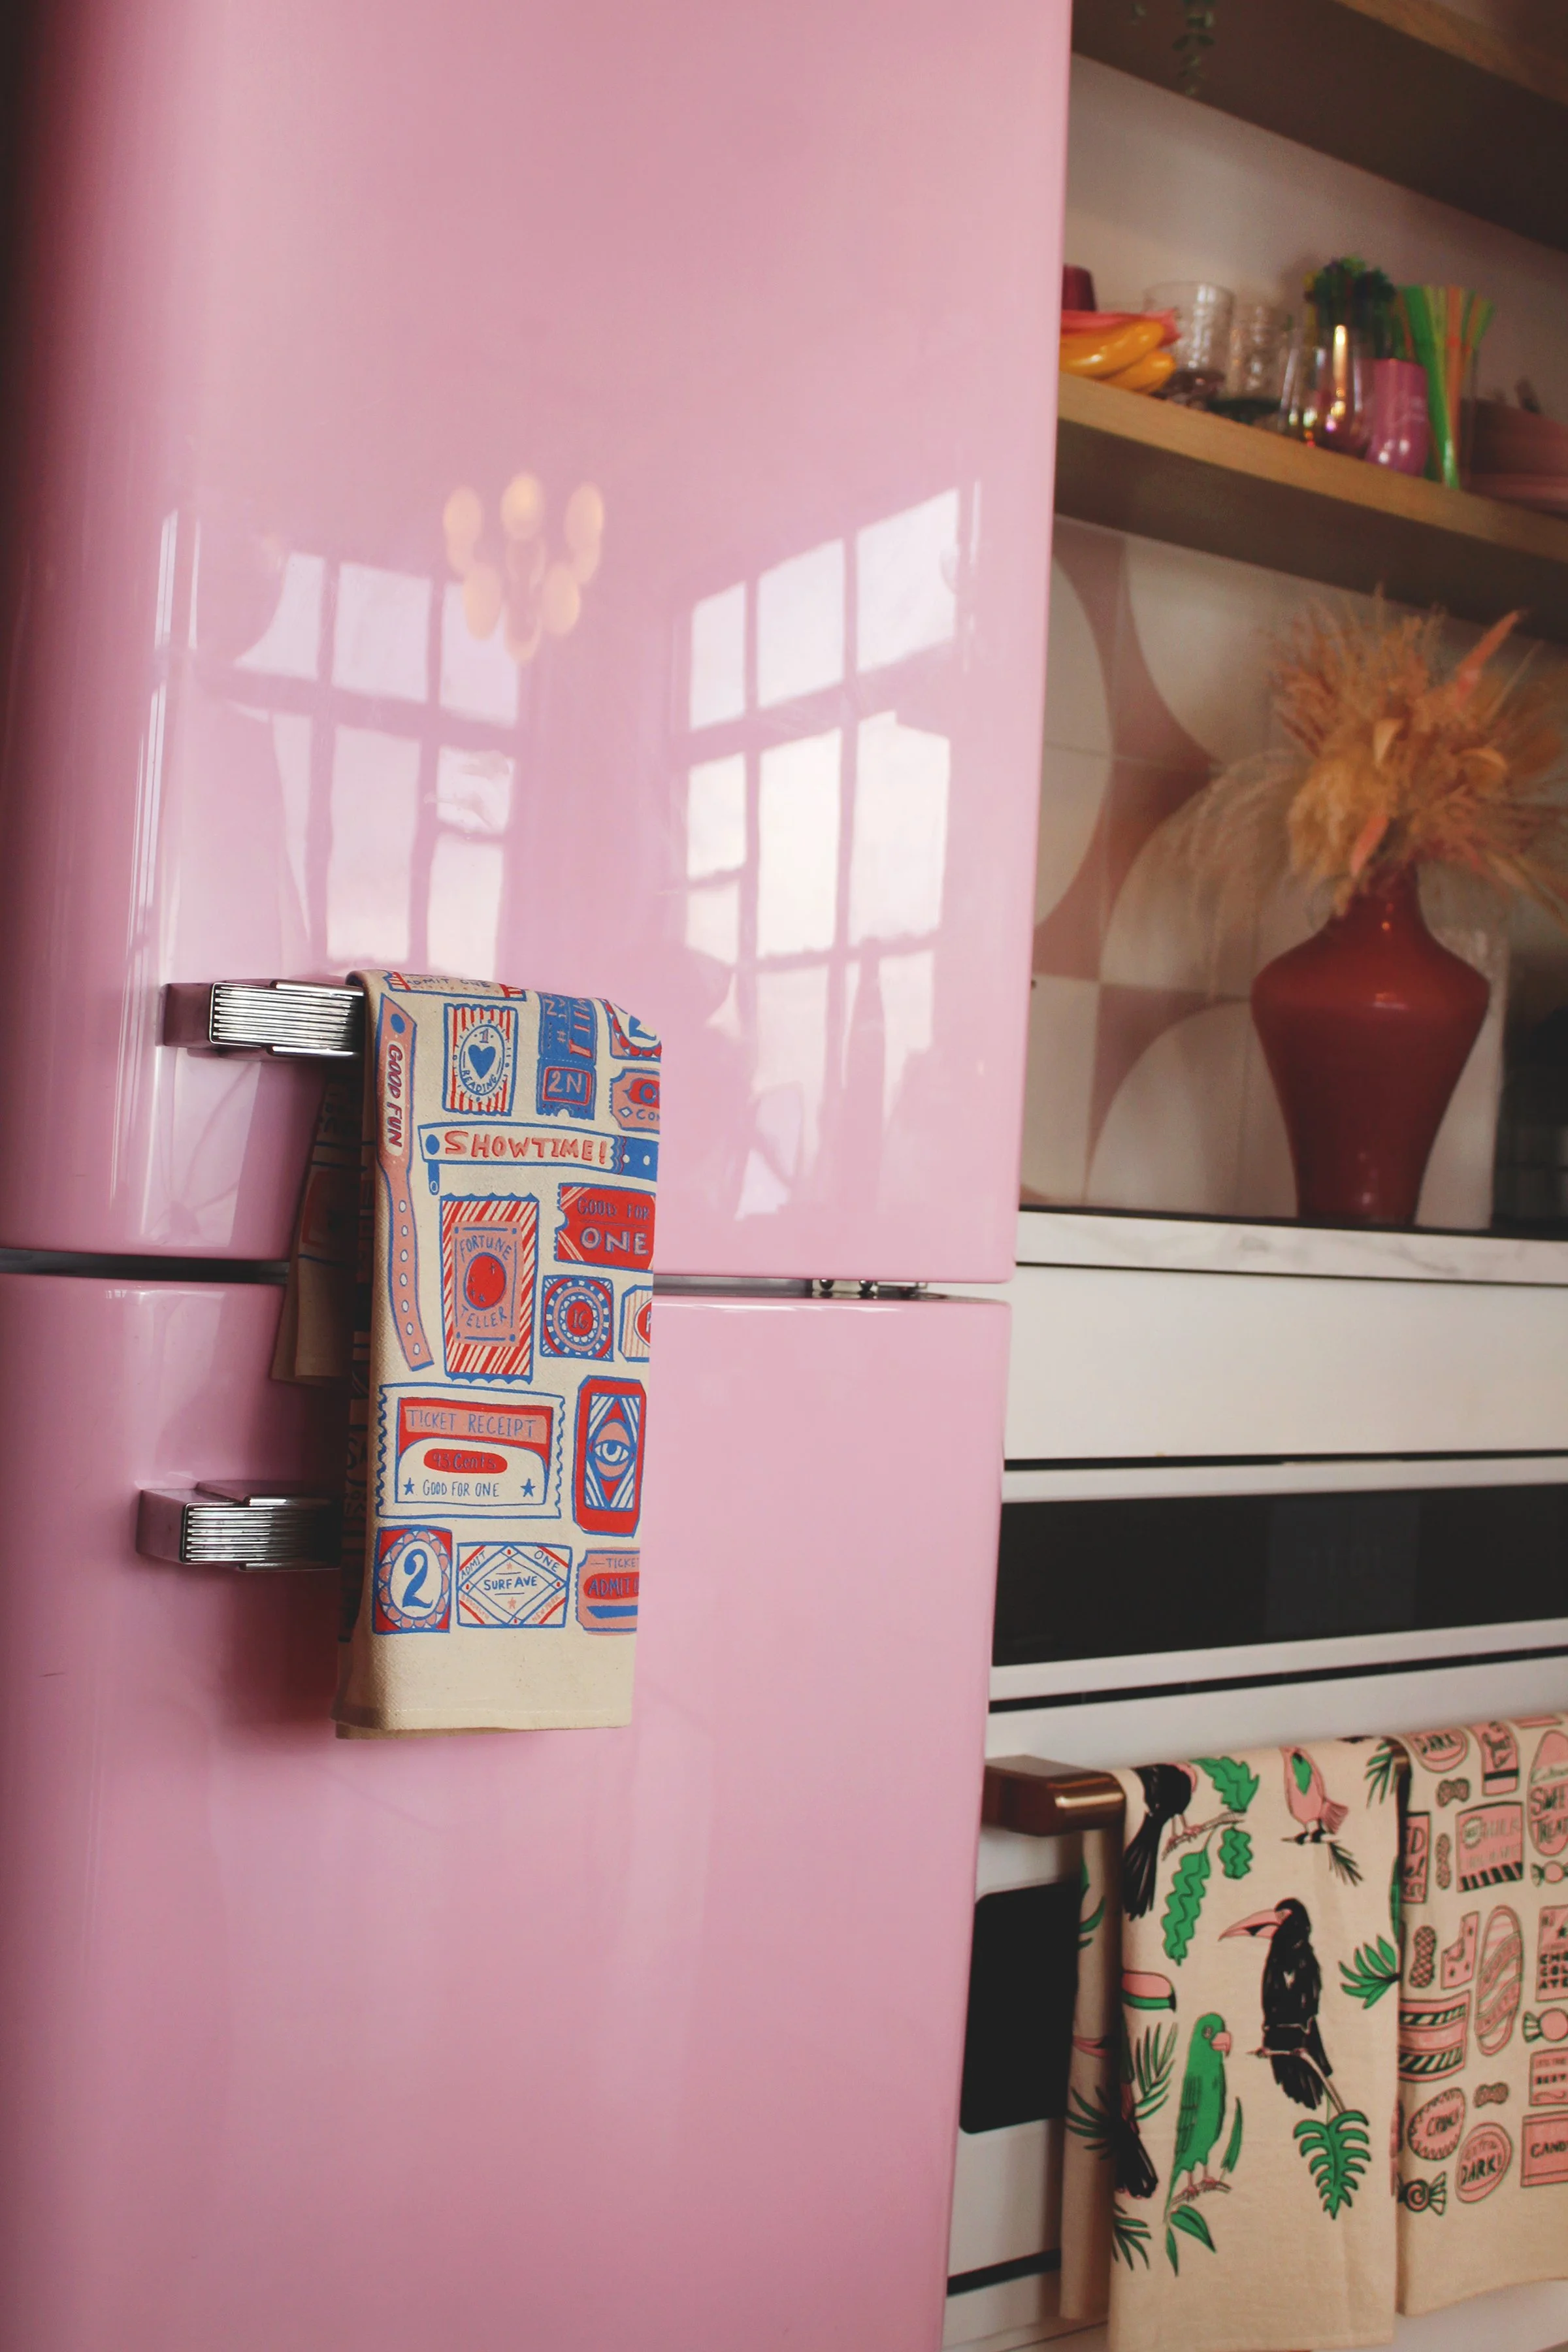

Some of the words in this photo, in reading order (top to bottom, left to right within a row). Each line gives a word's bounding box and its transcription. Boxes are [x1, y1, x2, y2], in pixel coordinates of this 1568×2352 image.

[479, 1028, 489, 1043] 1
[387, 1044, 403, 1099] GOOD
[461, 1070, 497, 1092] READING
[547, 1070, 582, 1094] 2N
[387, 1102, 402, 1147] FUN
[444, 1130, 608, 1166] SHOWTIME!
[577, 1196, 617, 1217] GOOD
[627, 1203, 649, 1220] FOR
[459, 1235, 512, 1263] FORTUNE
[580, 1226, 649, 1255] ONE
[460, 1303, 508, 1329] TELLER
[406, 1409, 457, 1431] TICKET
[468, 1413, 536, 1437] RECEIPT
[423, 1479, 448, 1495] GOOD
[451, 1481, 470, 1497] FOR
[475, 1482, 500, 1497] ONE
[461, 1550, 487, 1580] ADMIT
[534, 1550, 561, 1573] ONE
[606, 1557, 639, 1569] TICKE
[401, 1548, 434, 1609] 2
[483, 1578, 512, 1591] SURF
[514, 1575, 538, 1588] AVE
[587, 1578, 630, 1597] ADMIT
[1530, 2140, 1568, 2159] CAND
